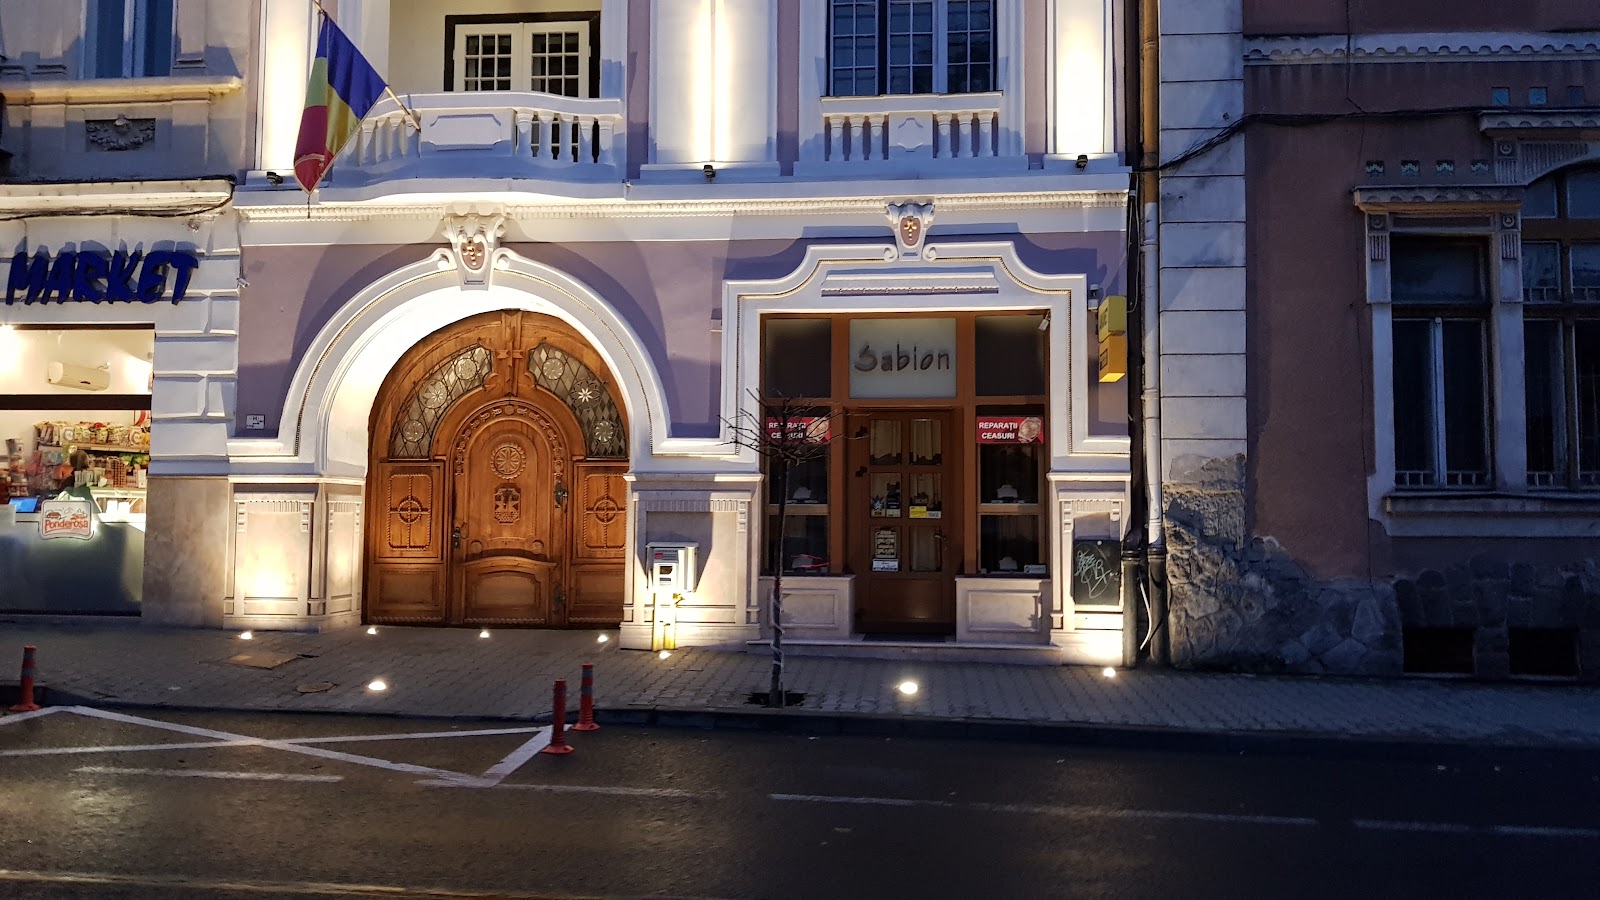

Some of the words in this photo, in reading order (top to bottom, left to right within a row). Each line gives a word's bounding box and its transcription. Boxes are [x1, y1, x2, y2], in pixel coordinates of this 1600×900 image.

[6, 250, 199, 305] MARKET
[854, 344, 949, 371] Sabion
[45, 518, 88, 530] Ponderosa
